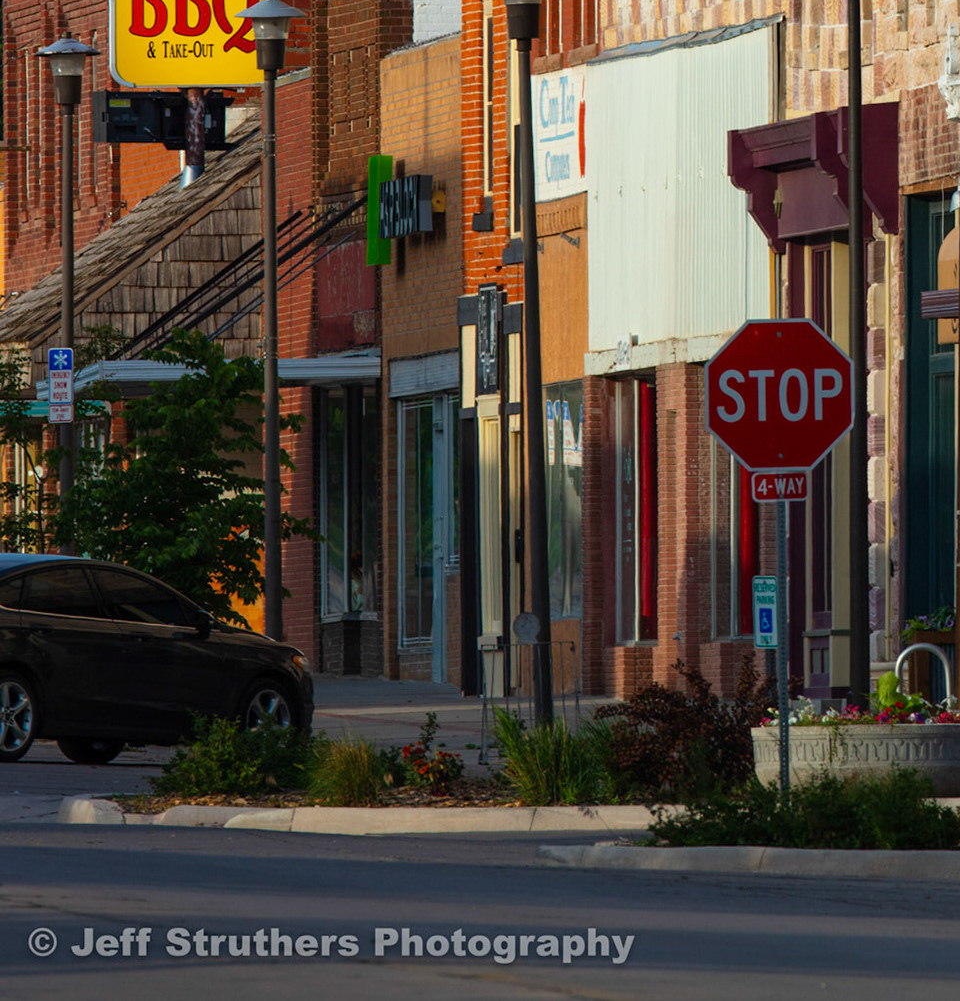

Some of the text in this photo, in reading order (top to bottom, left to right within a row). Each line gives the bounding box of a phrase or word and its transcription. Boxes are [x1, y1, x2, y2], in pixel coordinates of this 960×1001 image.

[147, 42, 157, 59] &
[716, 367, 843, 423] STOP
[757, 477, 804, 495] 4-WAY
[753, 582, 776, 592] RESERVED
[756, 595, 775, 604] PARKING
